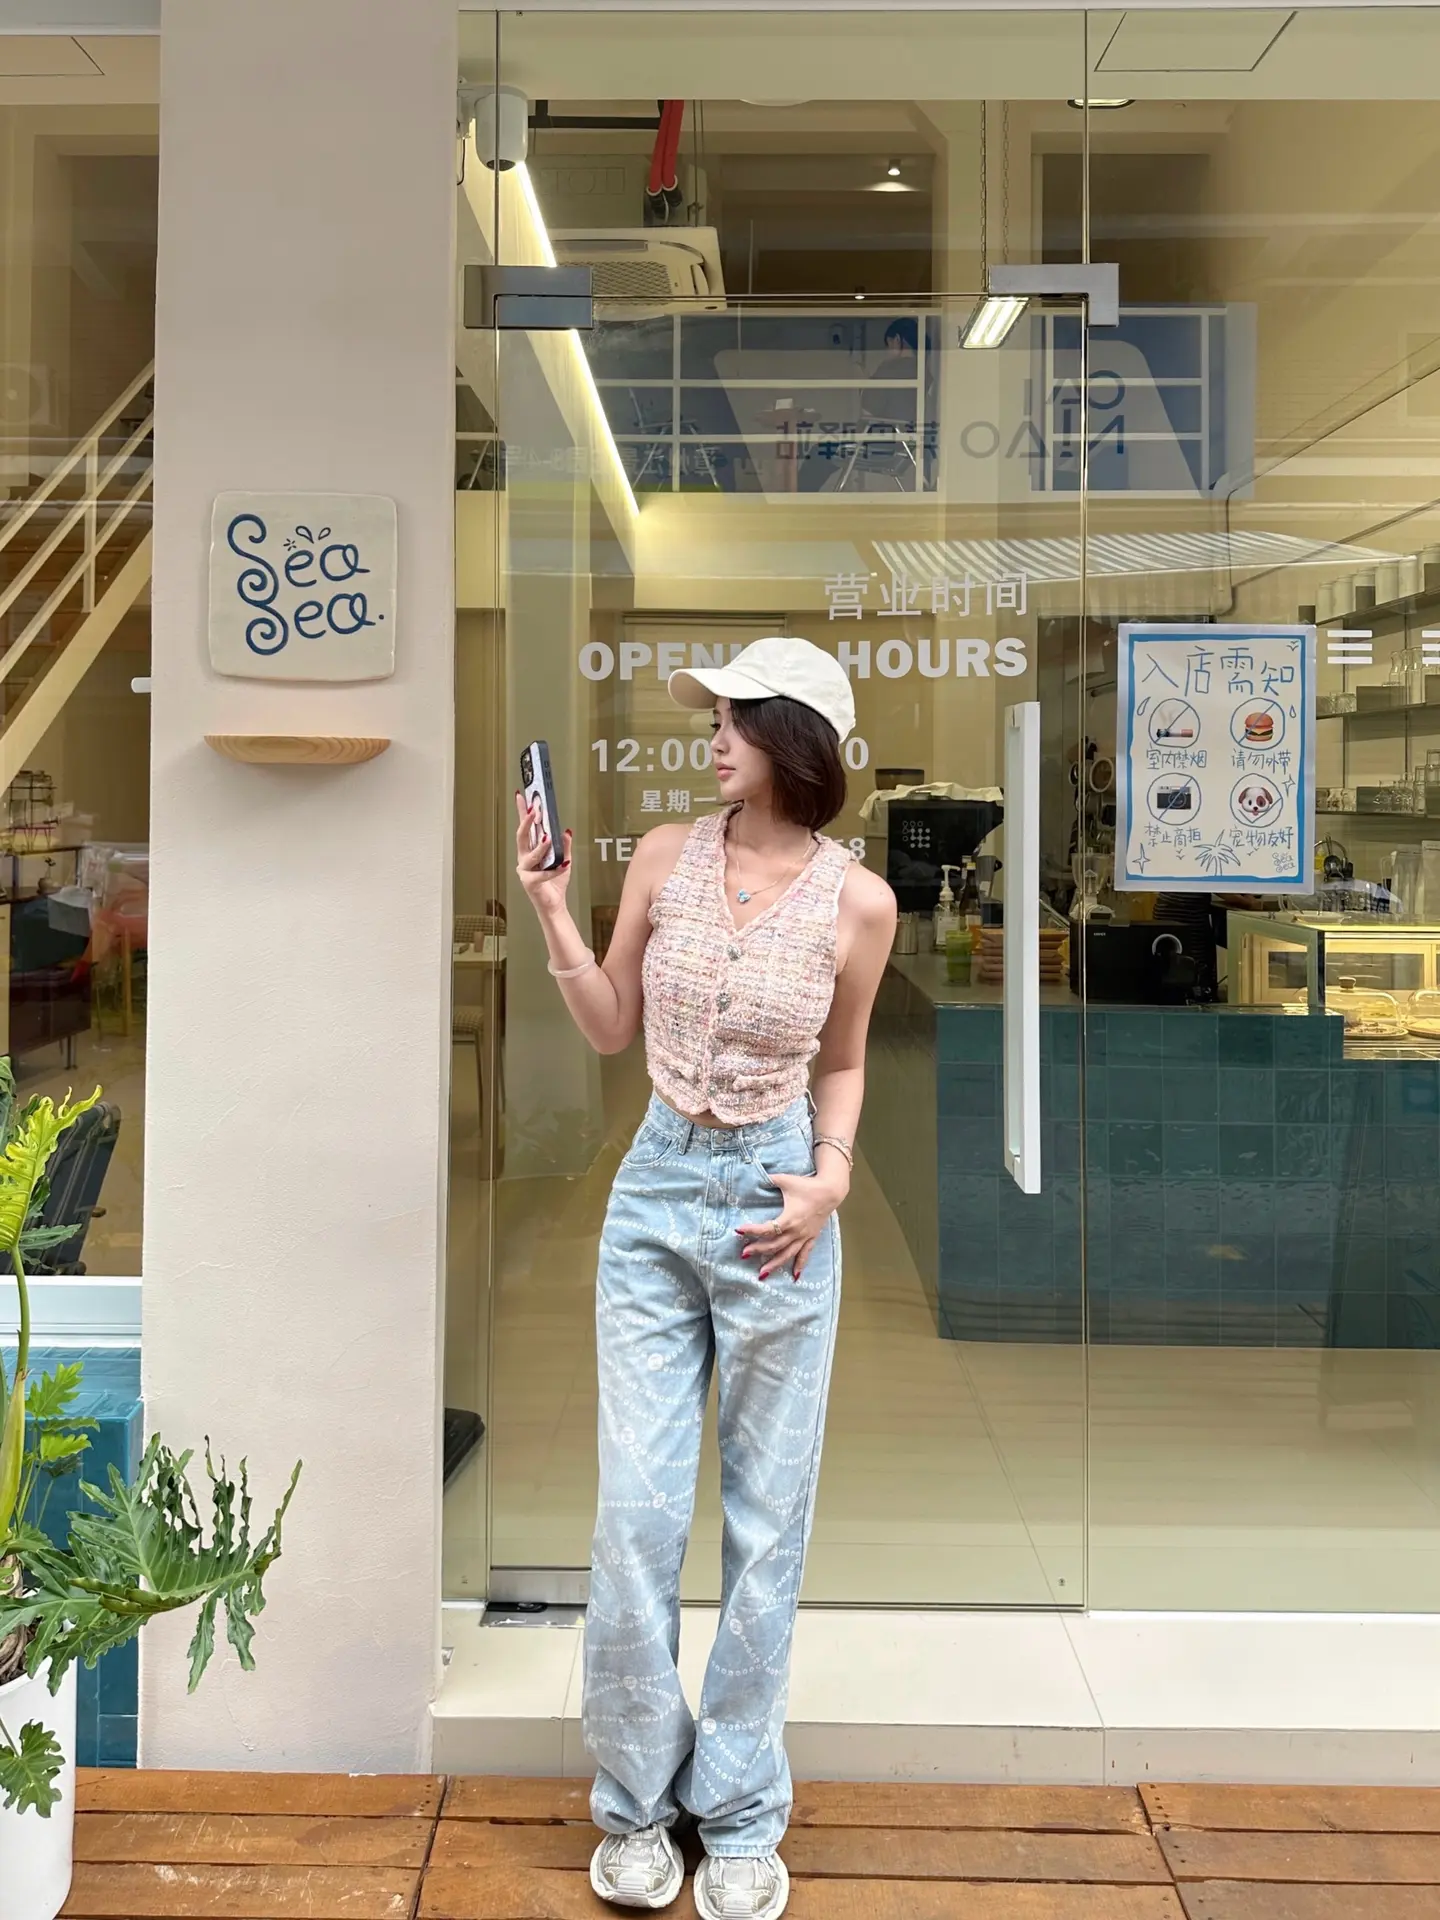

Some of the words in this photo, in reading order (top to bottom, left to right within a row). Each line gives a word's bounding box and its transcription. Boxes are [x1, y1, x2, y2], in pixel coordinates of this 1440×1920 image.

[227, 513, 371, 604] Sea
[824, 571, 1028, 621] 营业时间
[838, 637, 1028, 679] HOURS
[1142, 645, 1295, 697] 入店需知
[1146, 743, 1207, 770] 室内禁烟
[1231, 749, 1292, 775] 请勿外带
[1144, 822, 1202, 848] 禁止商拍
[1229, 826, 1294, 849] 宠物友好
[594, 838, 640, 862] TE
